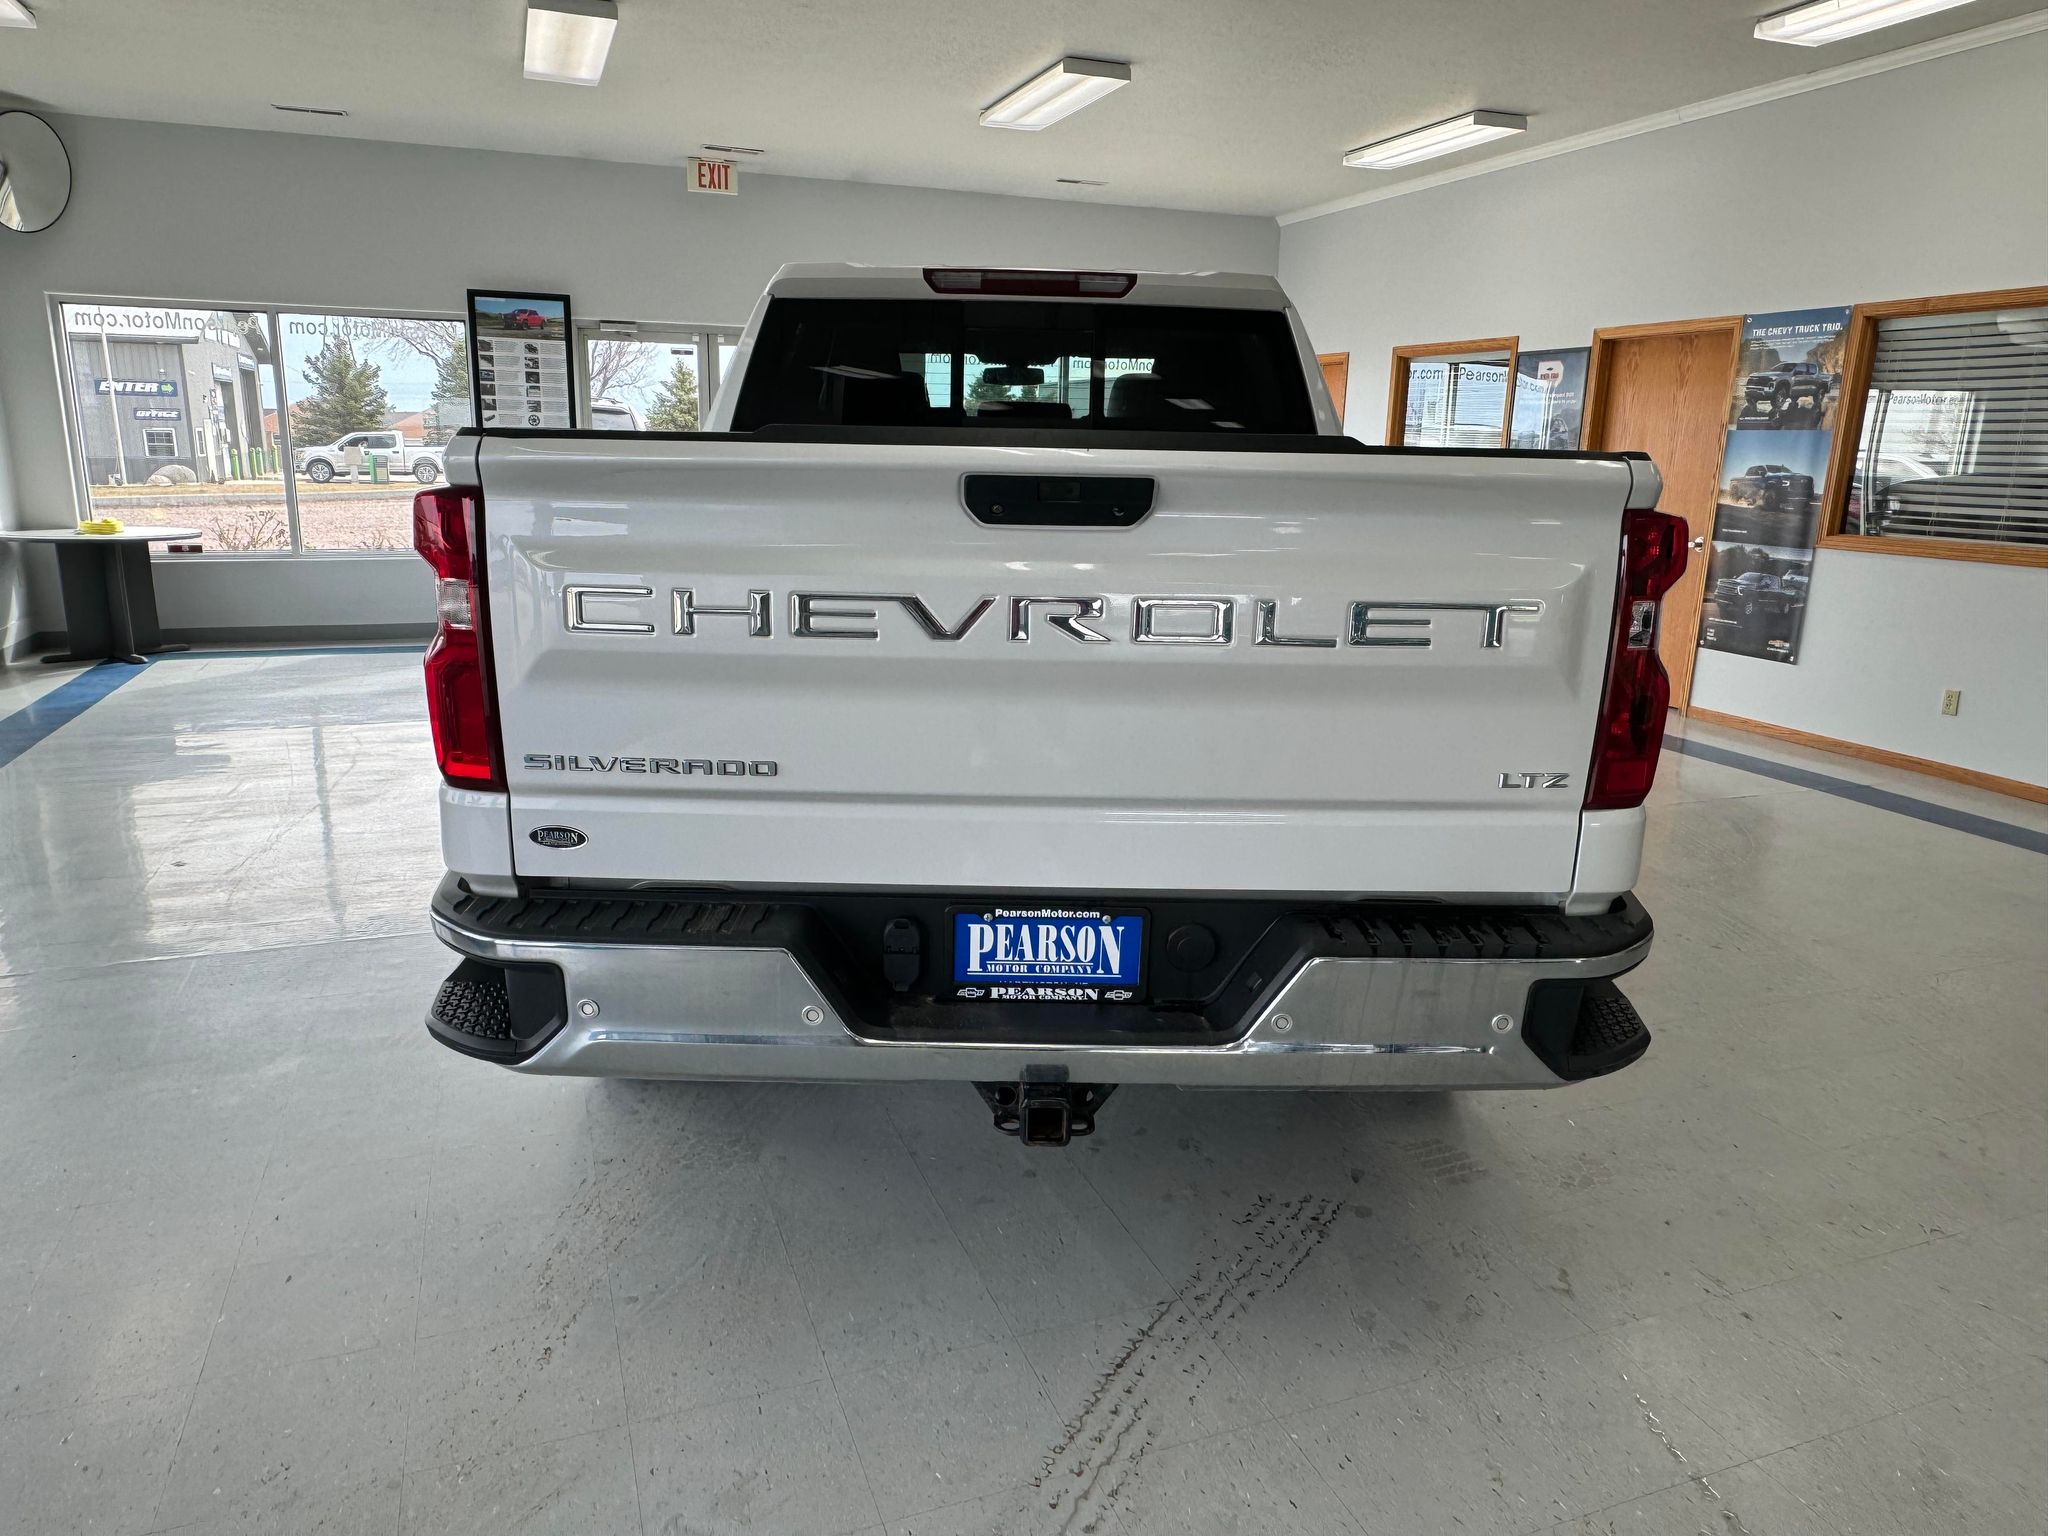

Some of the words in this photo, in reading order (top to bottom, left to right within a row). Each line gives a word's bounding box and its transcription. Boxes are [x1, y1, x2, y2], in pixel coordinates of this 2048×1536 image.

[698, 163, 730, 190] EXIT
[1753, 328, 1767, 337] THE
[1768, 326, 1793, 336] CHEVY
[1795, 324, 1820, 334] TRUCK
[1822, 322, 1843, 332] TRIO.
[98, 381, 159, 393] ENTER
[564, 585, 1542, 649] CHEVROLET
[524, 754, 778, 776] SILVERADO
[1498, 773, 1570, 789] LTZ
[537, 830, 579, 844] PEARSON
[995, 908, 1101, 919] PearsonMotor.com
[967, 923, 1125, 974] PEARSON
[986, 964, 1028, 973] MOTOR
[1035, 964, 1094, 974] COMPANY
[989, 987, 1100, 1001] PEARSON
